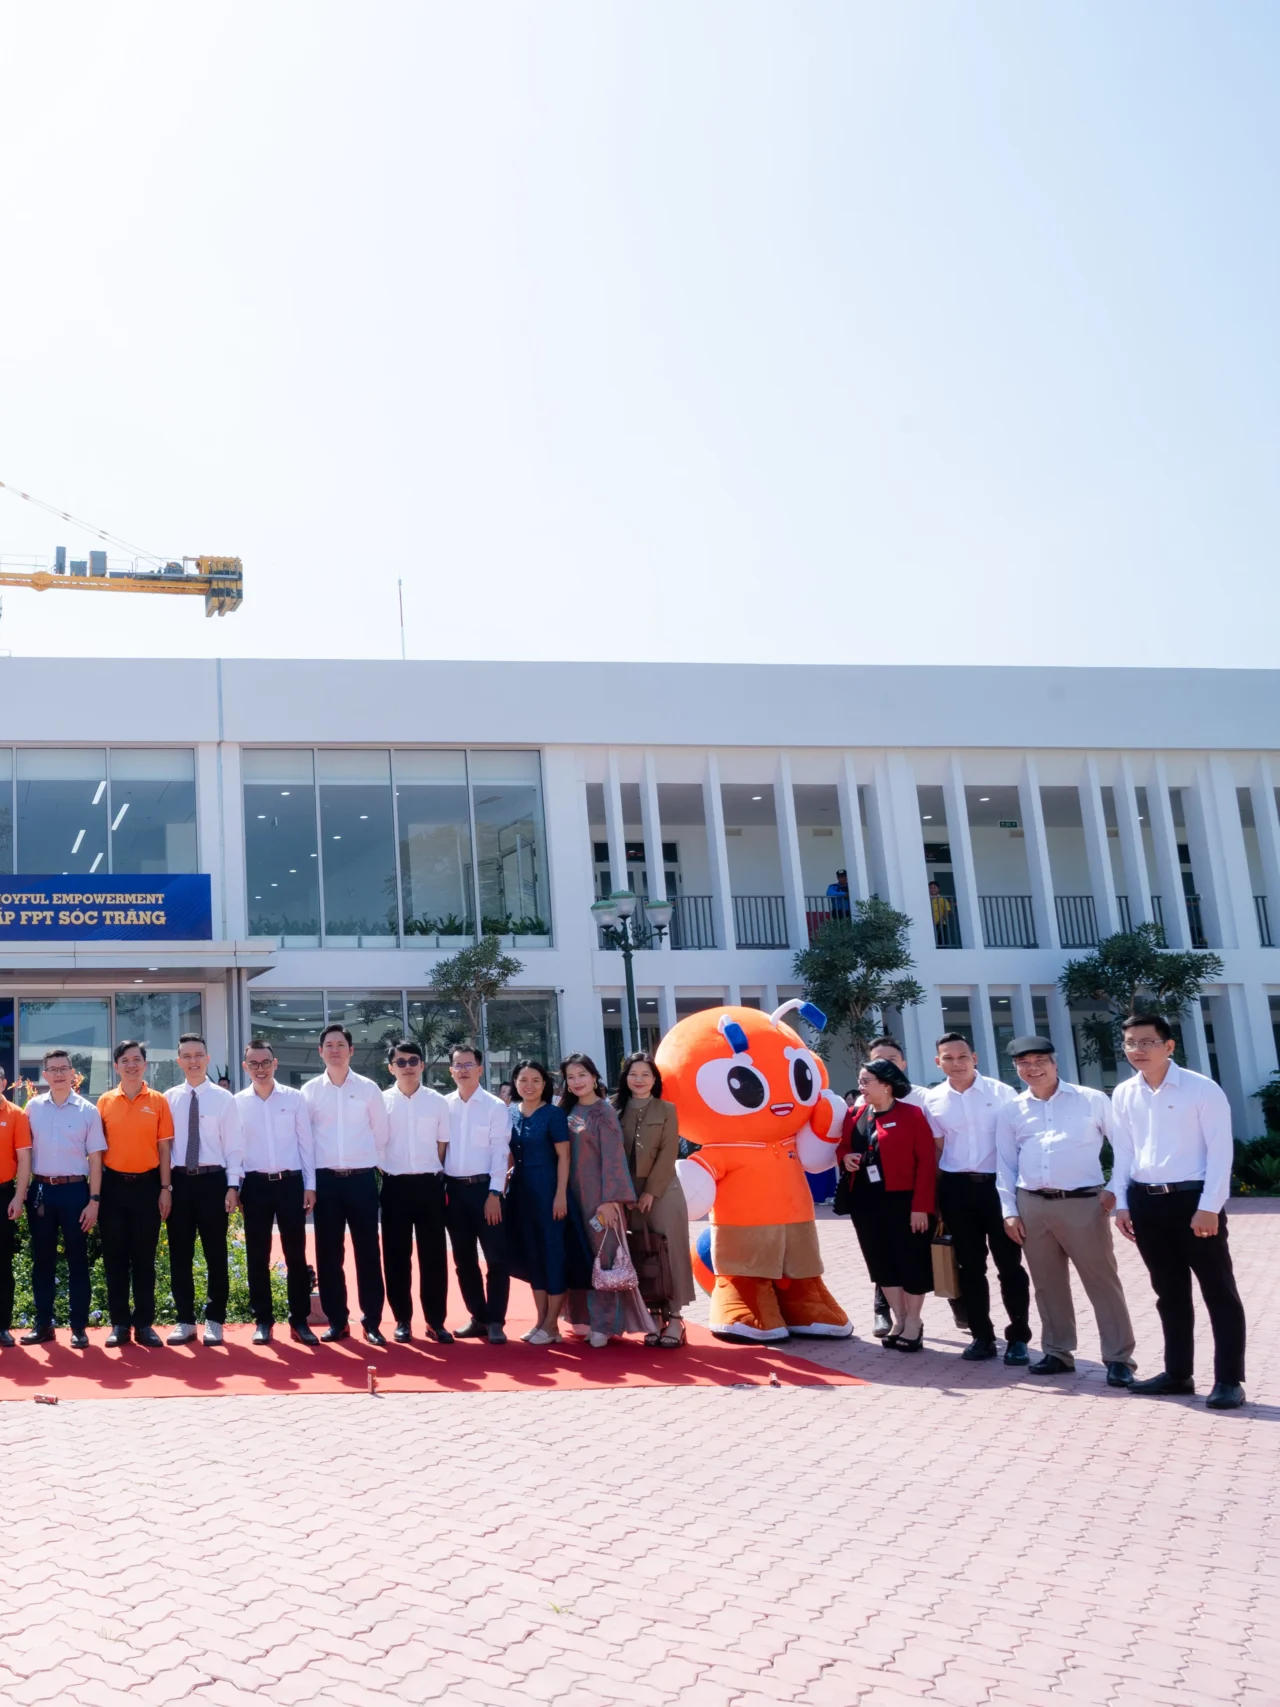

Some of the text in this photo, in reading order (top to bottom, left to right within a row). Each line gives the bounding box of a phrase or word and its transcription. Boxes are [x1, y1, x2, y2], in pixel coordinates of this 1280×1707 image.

[52, 893, 165, 905] EMPOWERMENT
[20, 911, 54, 925] FPT
[58, 908, 98, 925] SÓC
[102, 908, 167, 925] TRĂNG
